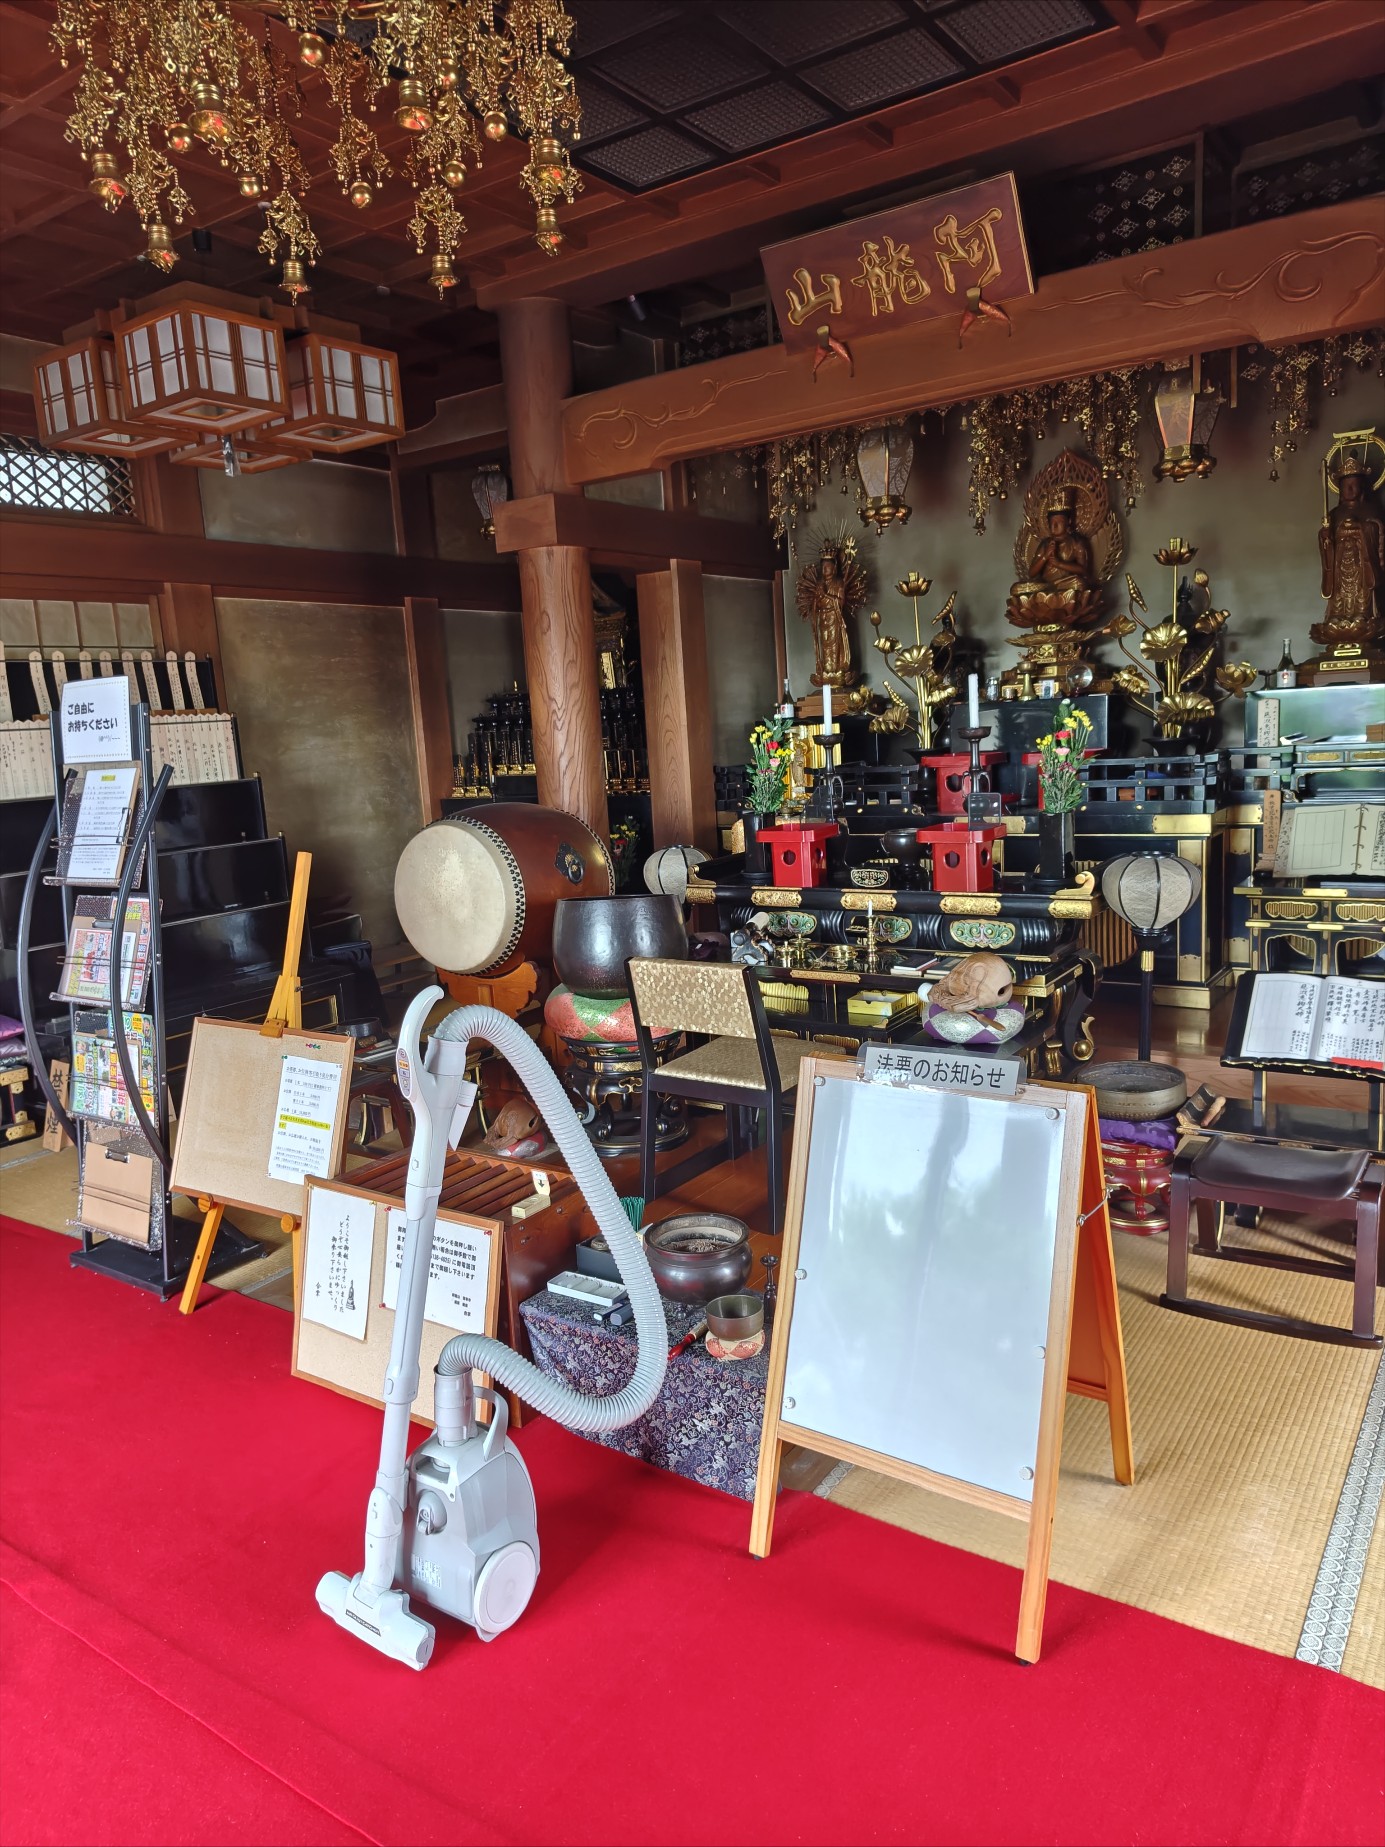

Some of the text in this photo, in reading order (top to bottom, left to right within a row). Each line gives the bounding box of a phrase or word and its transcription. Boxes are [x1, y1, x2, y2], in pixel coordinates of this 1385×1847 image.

[67, 702, 95, 716] ご自由に
[67, 717, 118, 733] お持ちください
[877, 1053, 1006, 1089] 法要のお知らせ
